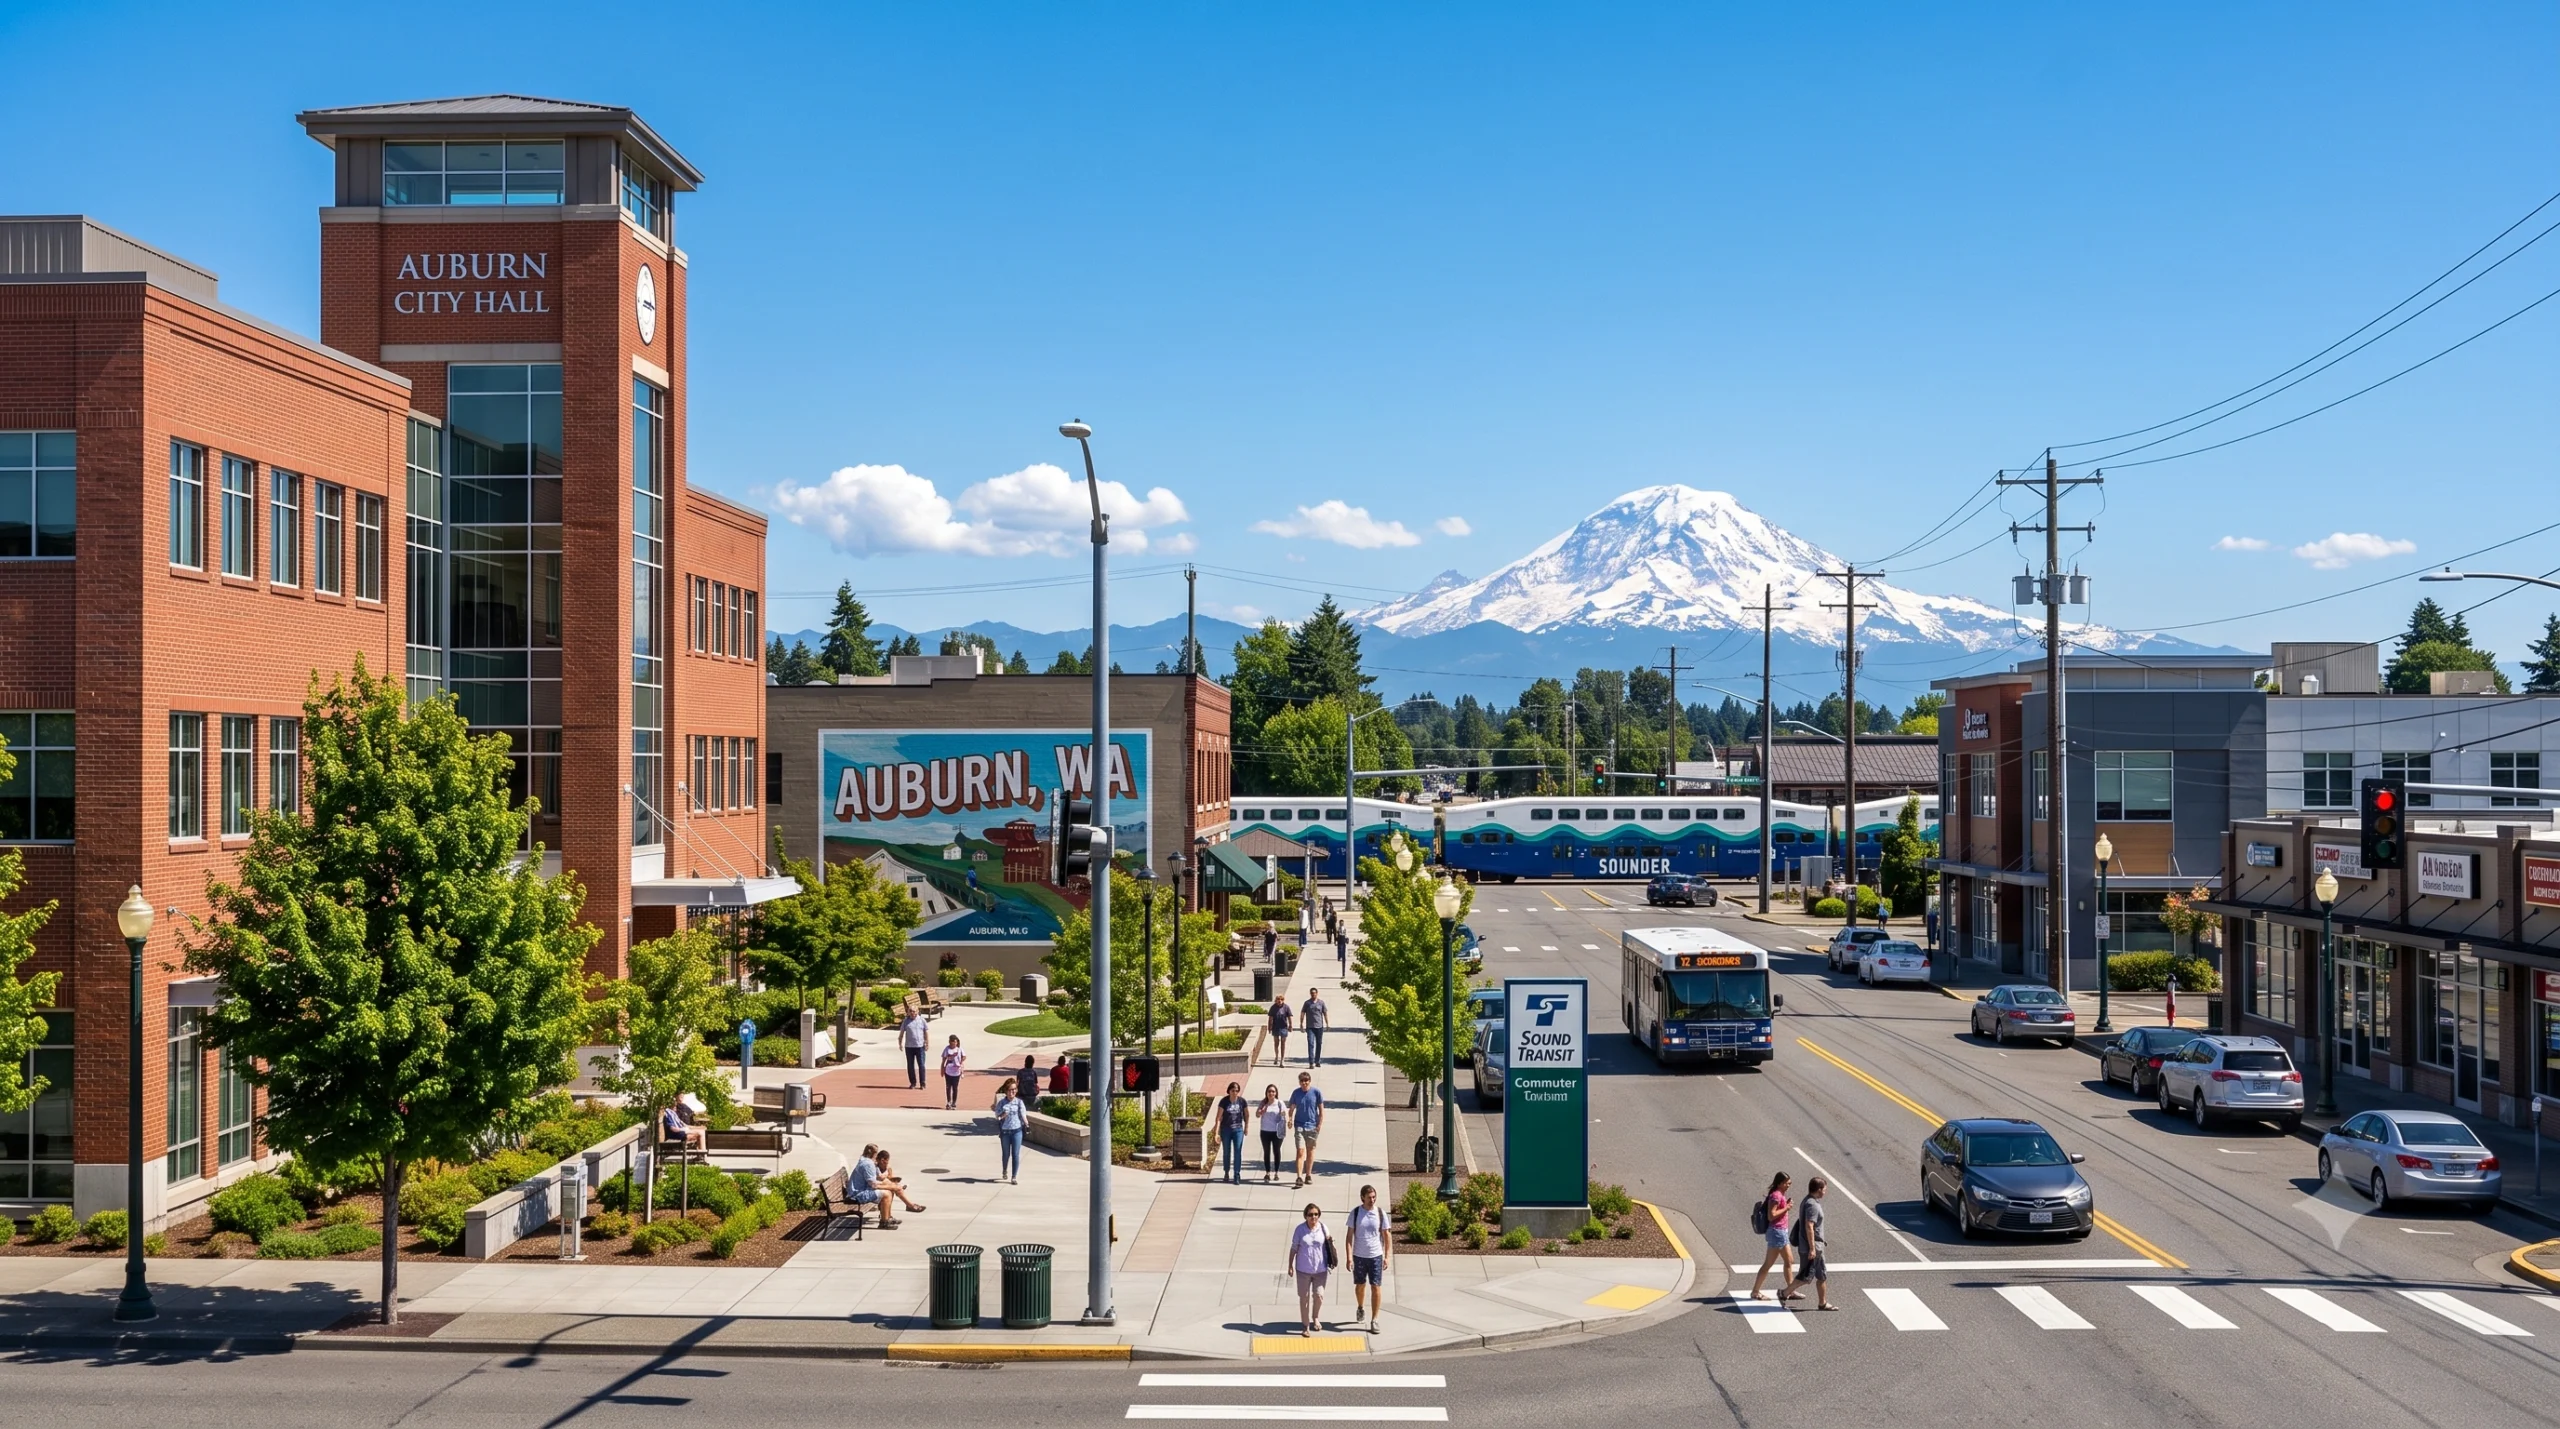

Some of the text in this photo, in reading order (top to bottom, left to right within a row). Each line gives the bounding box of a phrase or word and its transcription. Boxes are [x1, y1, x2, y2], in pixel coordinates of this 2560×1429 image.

[396, 252, 548, 280] AUBURN
[393, 290, 550, 315] CITY HALL
[834, 743, 1138, 822] AUBURN, WA
[1599, 858, 1671, 875] SOUNDER
[968, 927, 1007, 936] AUBURN,
[1514, 1077, 1578, 1089] Commuter
